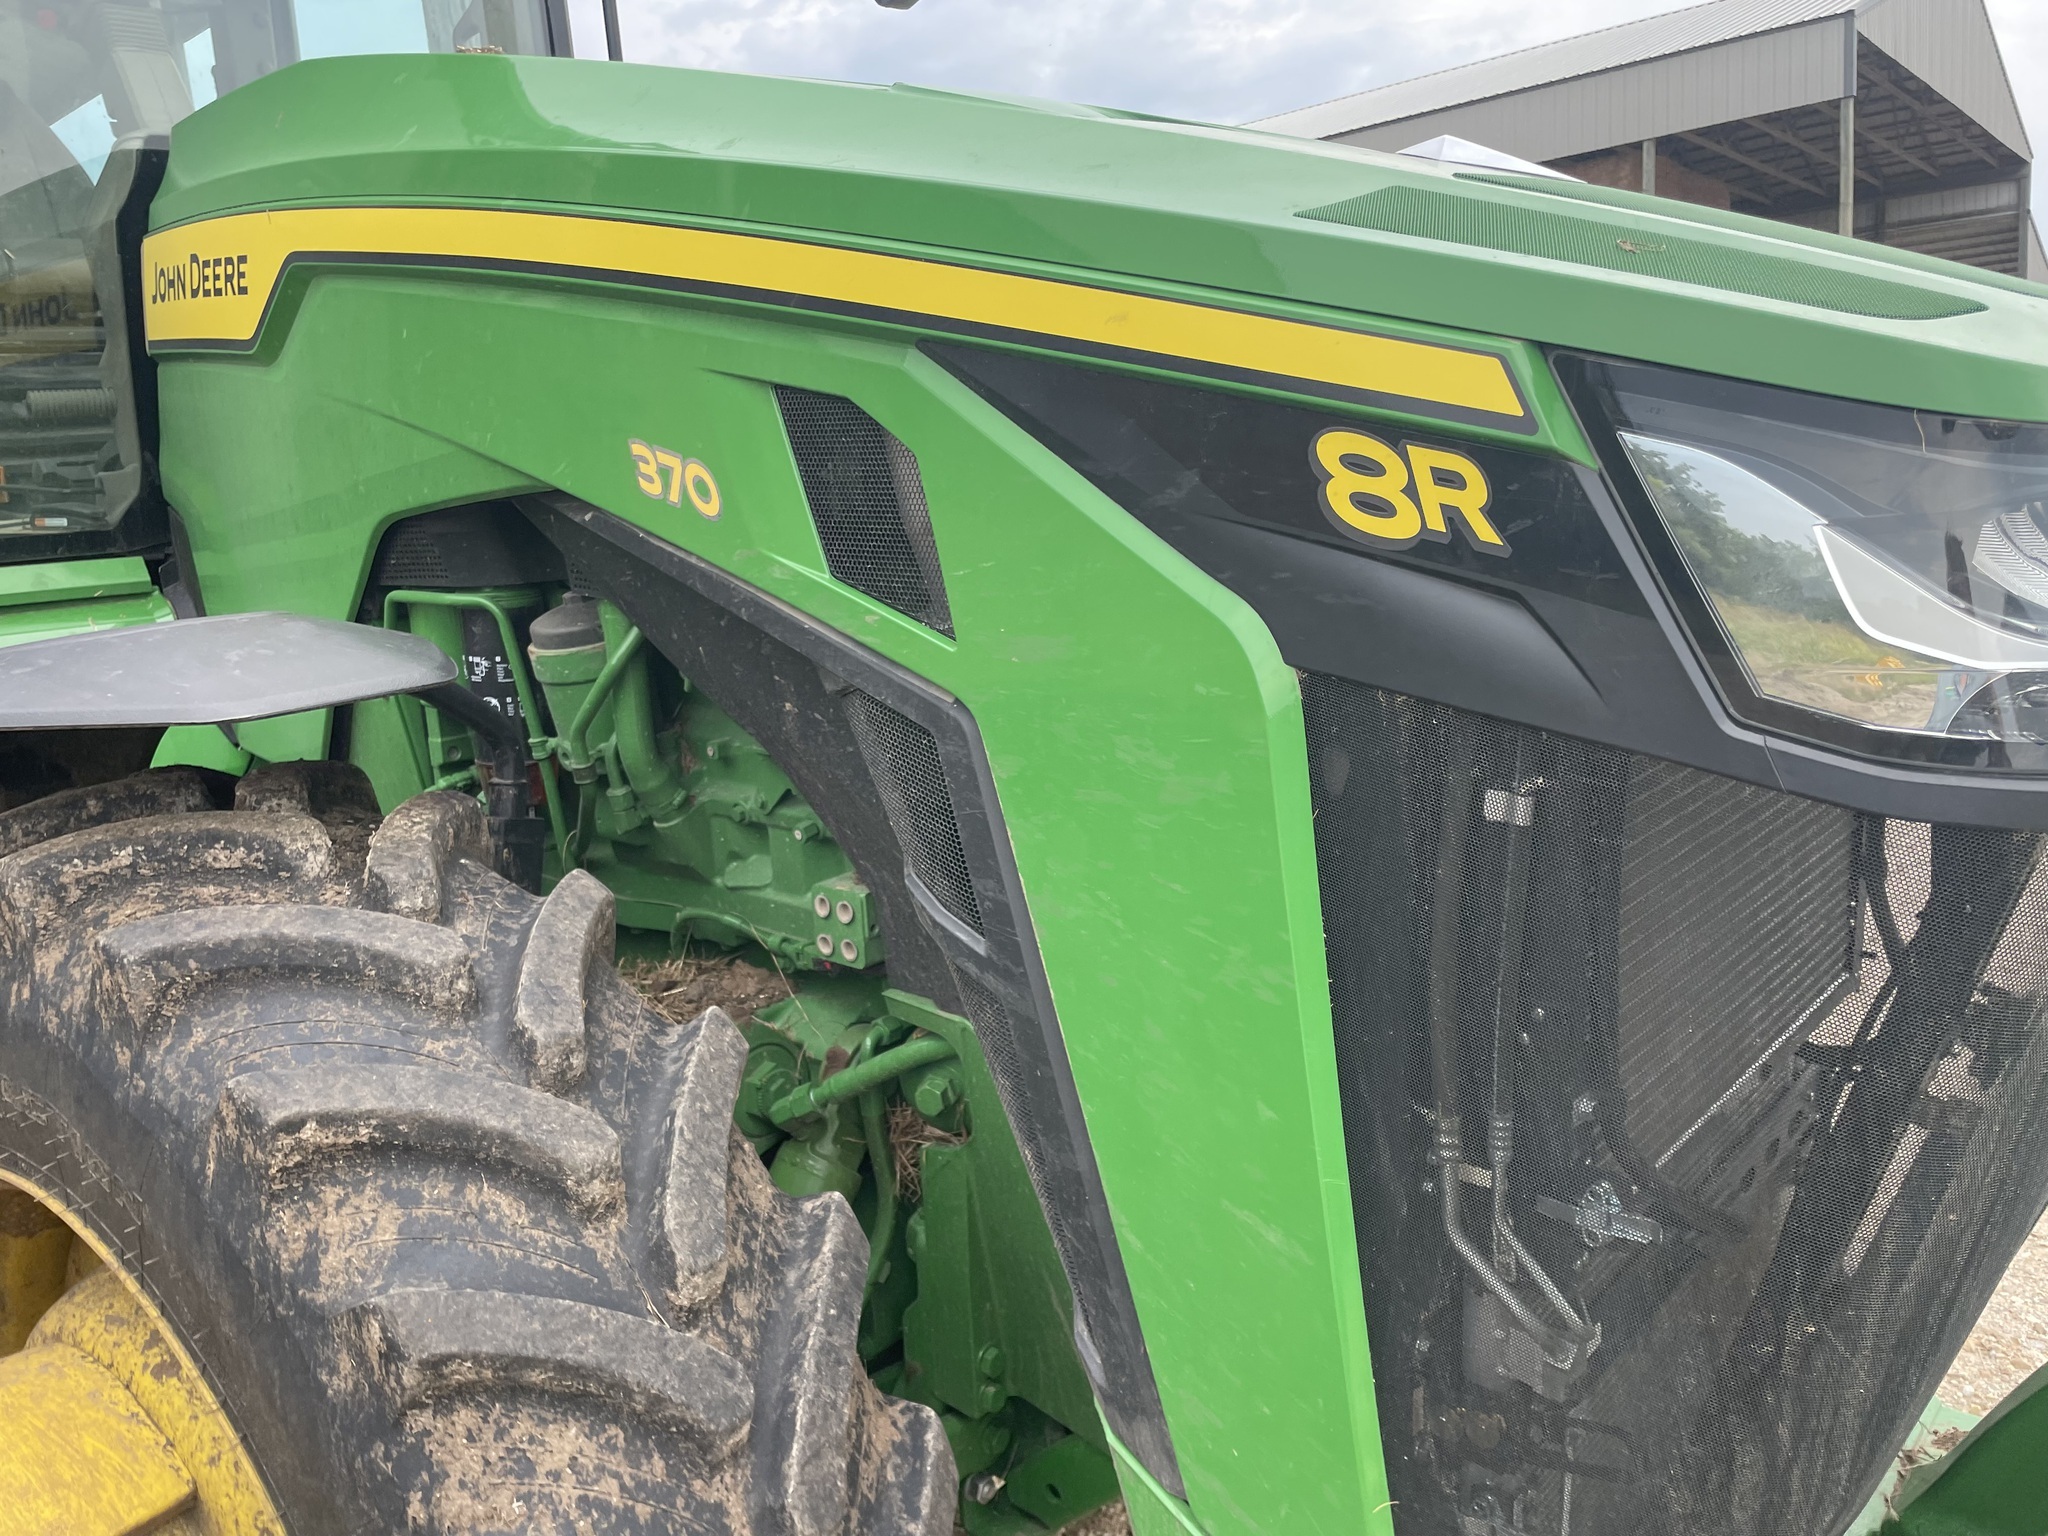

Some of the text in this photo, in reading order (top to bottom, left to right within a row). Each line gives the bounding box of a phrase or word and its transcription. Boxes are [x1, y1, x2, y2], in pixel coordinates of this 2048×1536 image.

[152, 253, 248, 304] JOHN DEERE
[629, 439, 722, 520] 370
[1311, 428, 1509, 553] 8R
